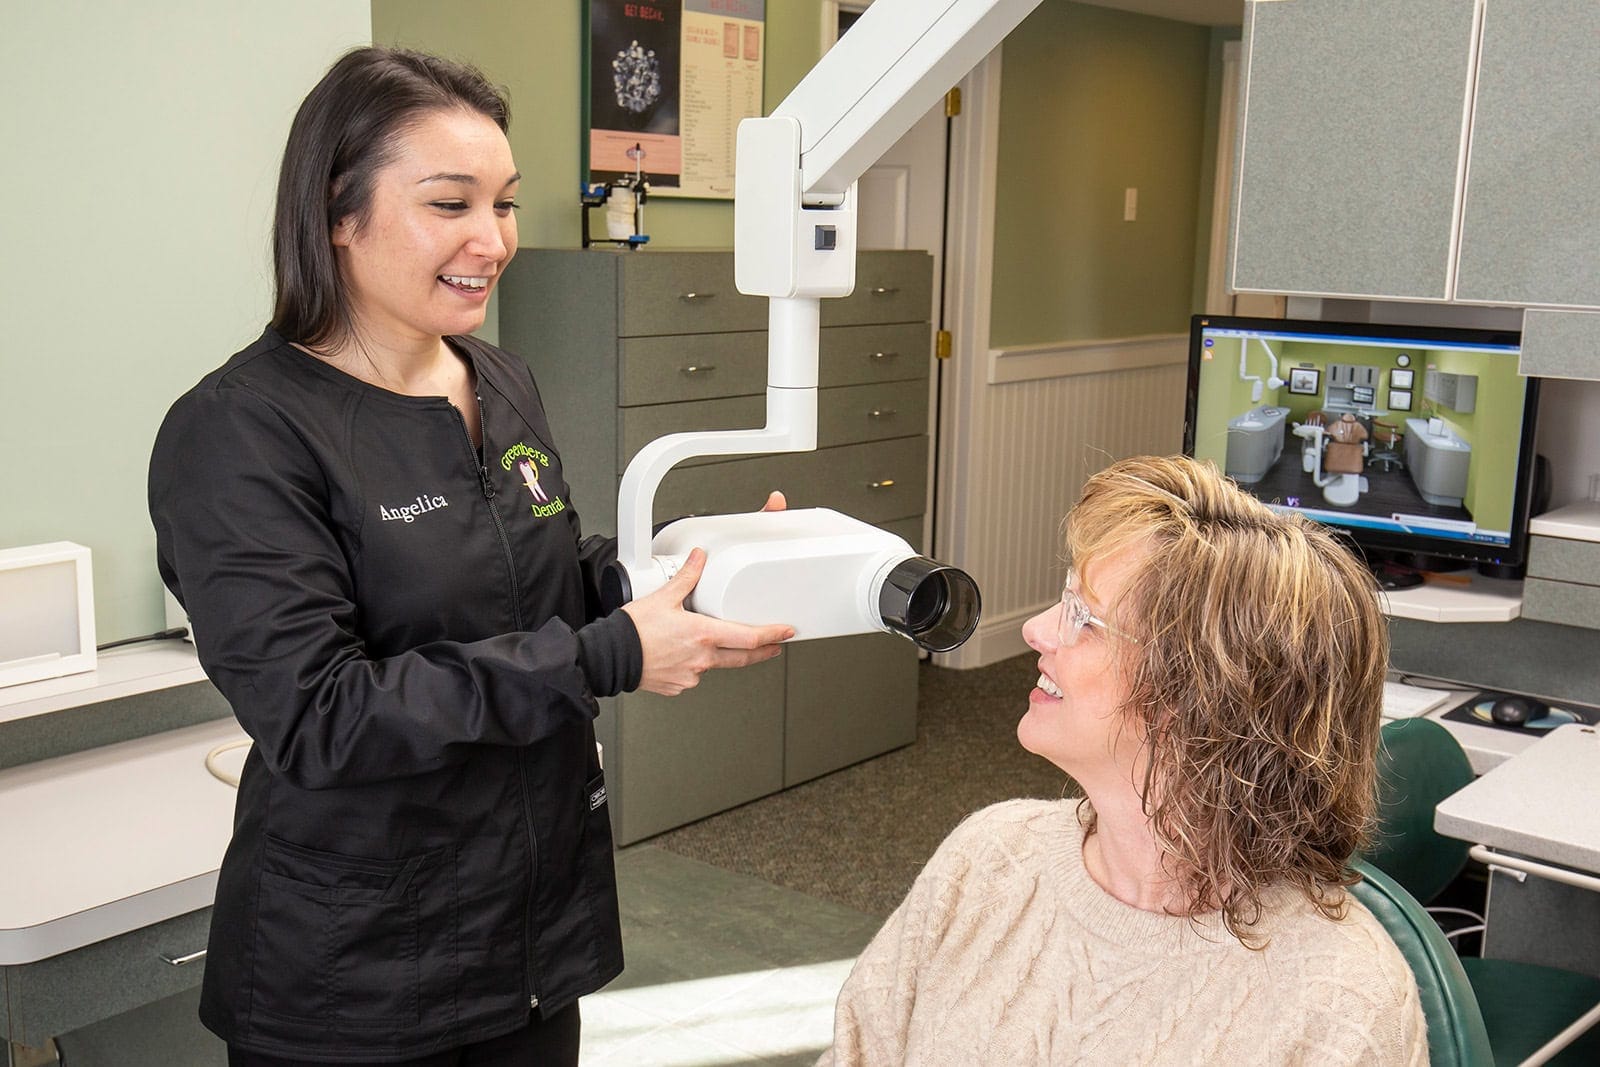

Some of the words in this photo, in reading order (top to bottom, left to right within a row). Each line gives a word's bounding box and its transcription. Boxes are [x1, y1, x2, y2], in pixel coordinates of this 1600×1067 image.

[501, 442, 549, 471] Greenberg
[379, 494, 449, 523] Angelica
[531, 495, 566, 518] Dental
